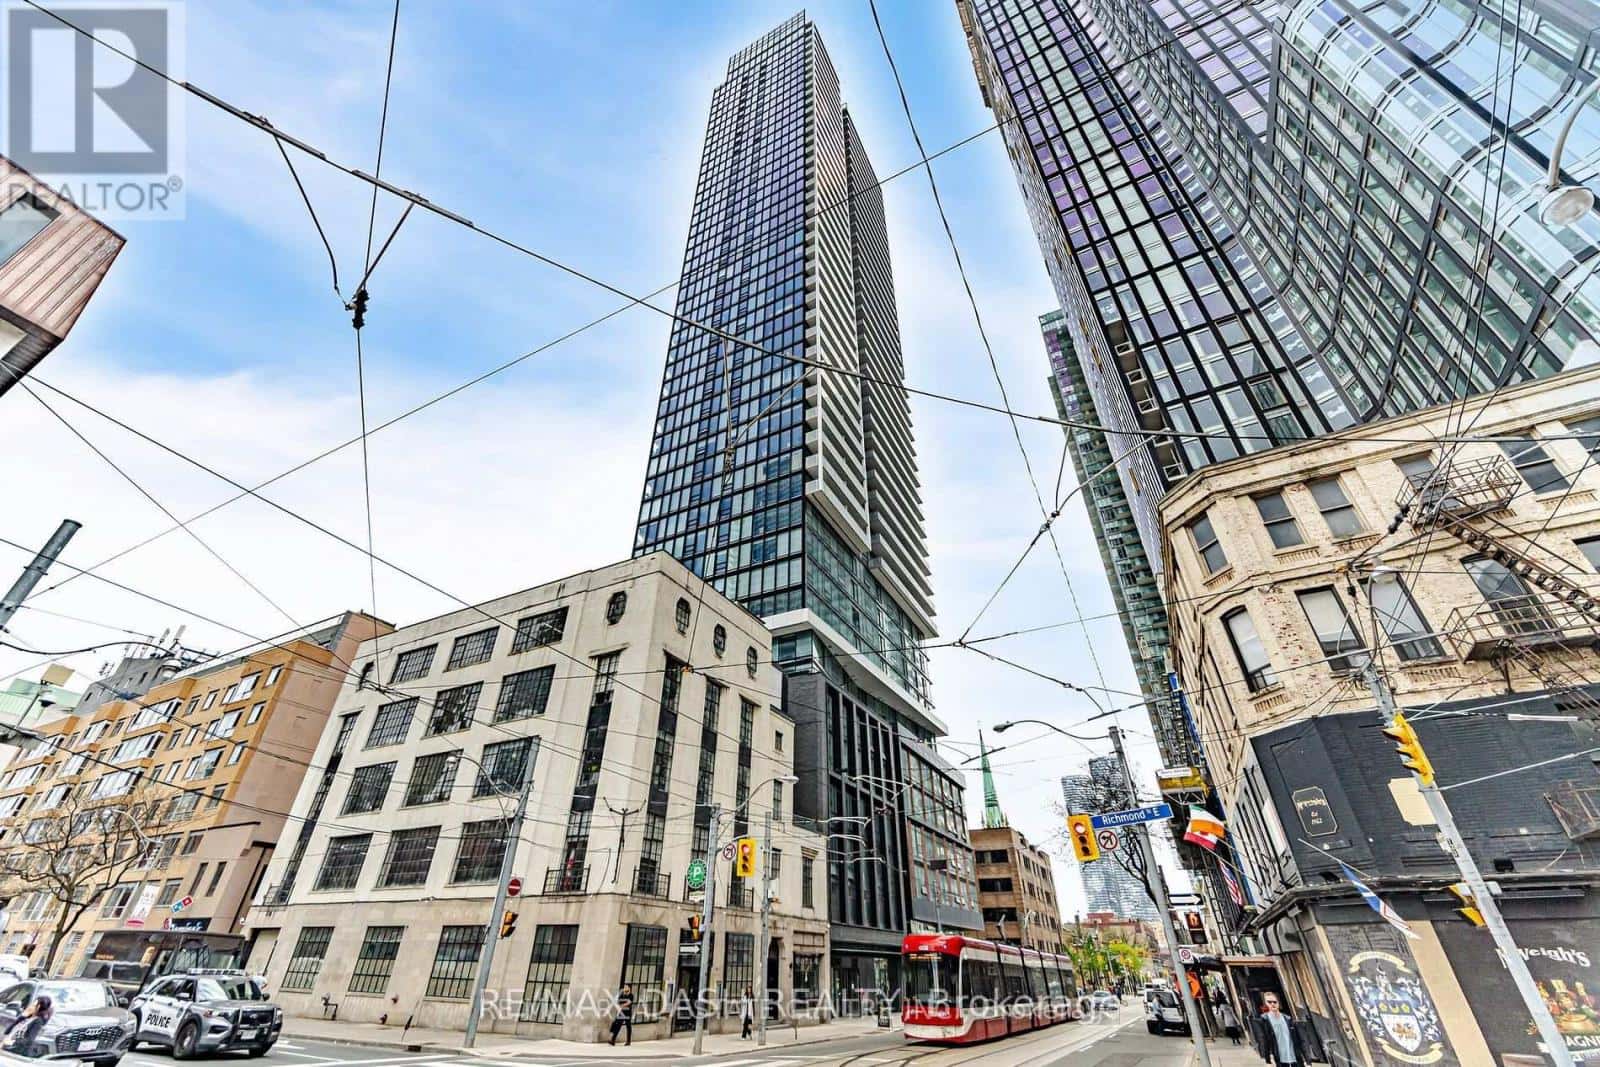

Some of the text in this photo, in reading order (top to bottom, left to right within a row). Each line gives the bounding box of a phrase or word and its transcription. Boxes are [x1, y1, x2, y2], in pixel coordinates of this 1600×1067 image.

[1102, 807, 1161, 825] Richmond E
[145, 1013, 171, 1028] POLICE
